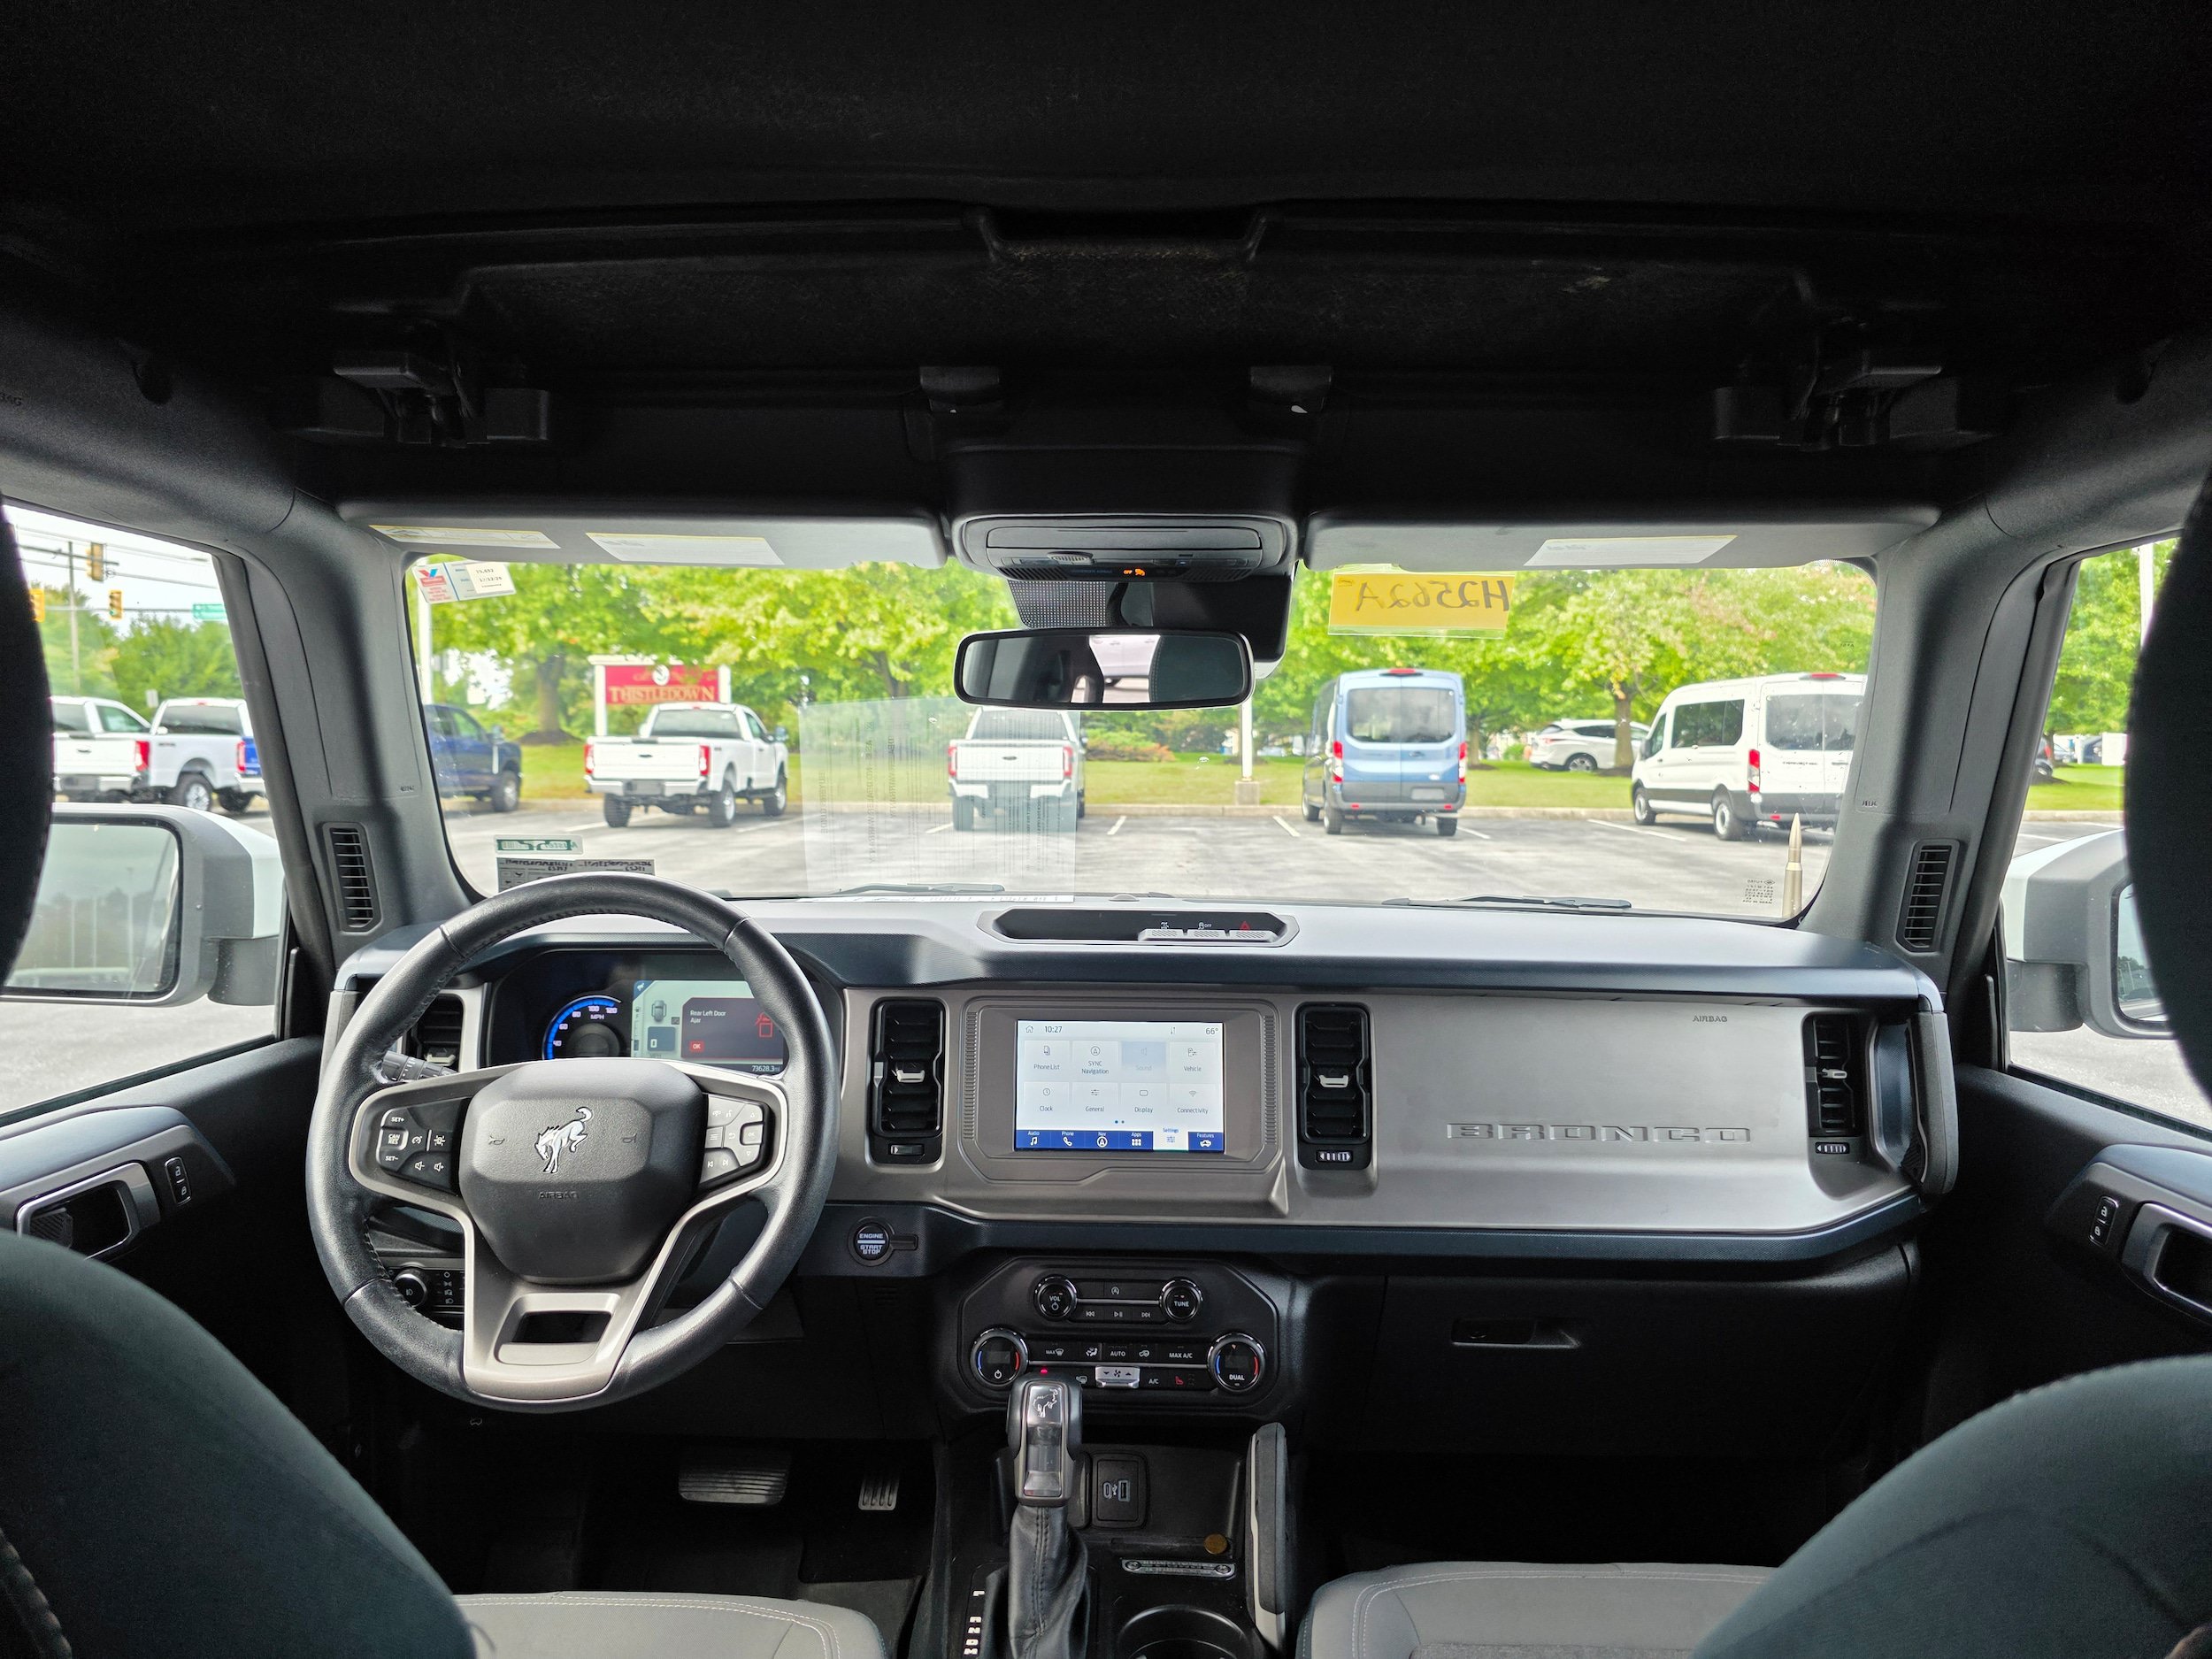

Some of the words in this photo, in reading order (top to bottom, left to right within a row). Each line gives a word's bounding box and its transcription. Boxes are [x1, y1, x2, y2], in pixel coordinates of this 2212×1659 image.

[608, 685, 716, 703] THISTLEDOWN
[649, 1039, 657, 1048] 0
[1446, 1123, 1752, 1144] BRONCO
